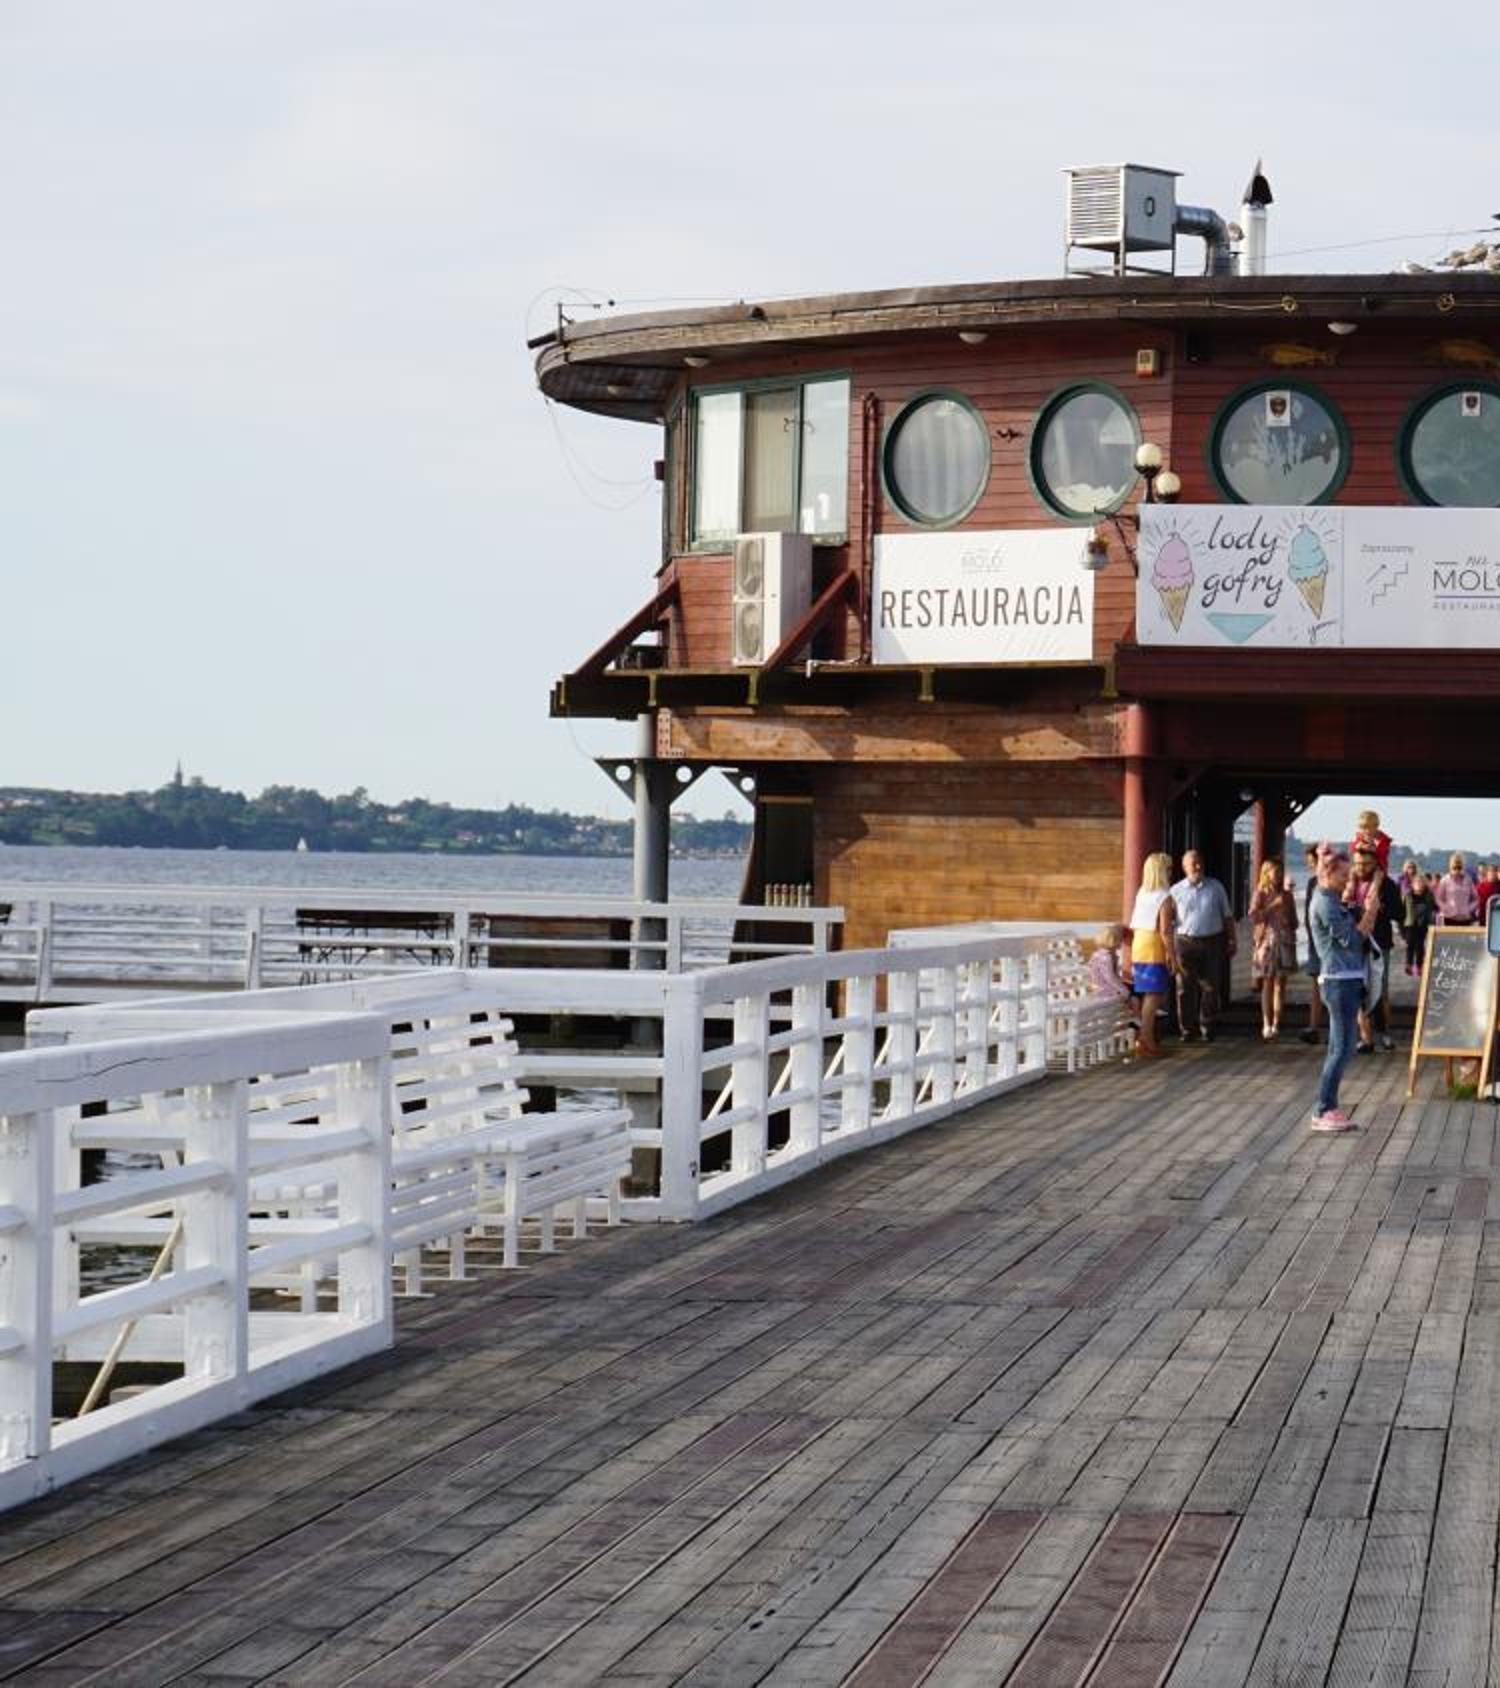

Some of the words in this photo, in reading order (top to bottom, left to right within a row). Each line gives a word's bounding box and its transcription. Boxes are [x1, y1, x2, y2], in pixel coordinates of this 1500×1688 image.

[1207, 514, 1279, 566] lody
[880, 585, 1084, 629] RESTAURACJA
[1201, 557, 1284, 608] gofry
